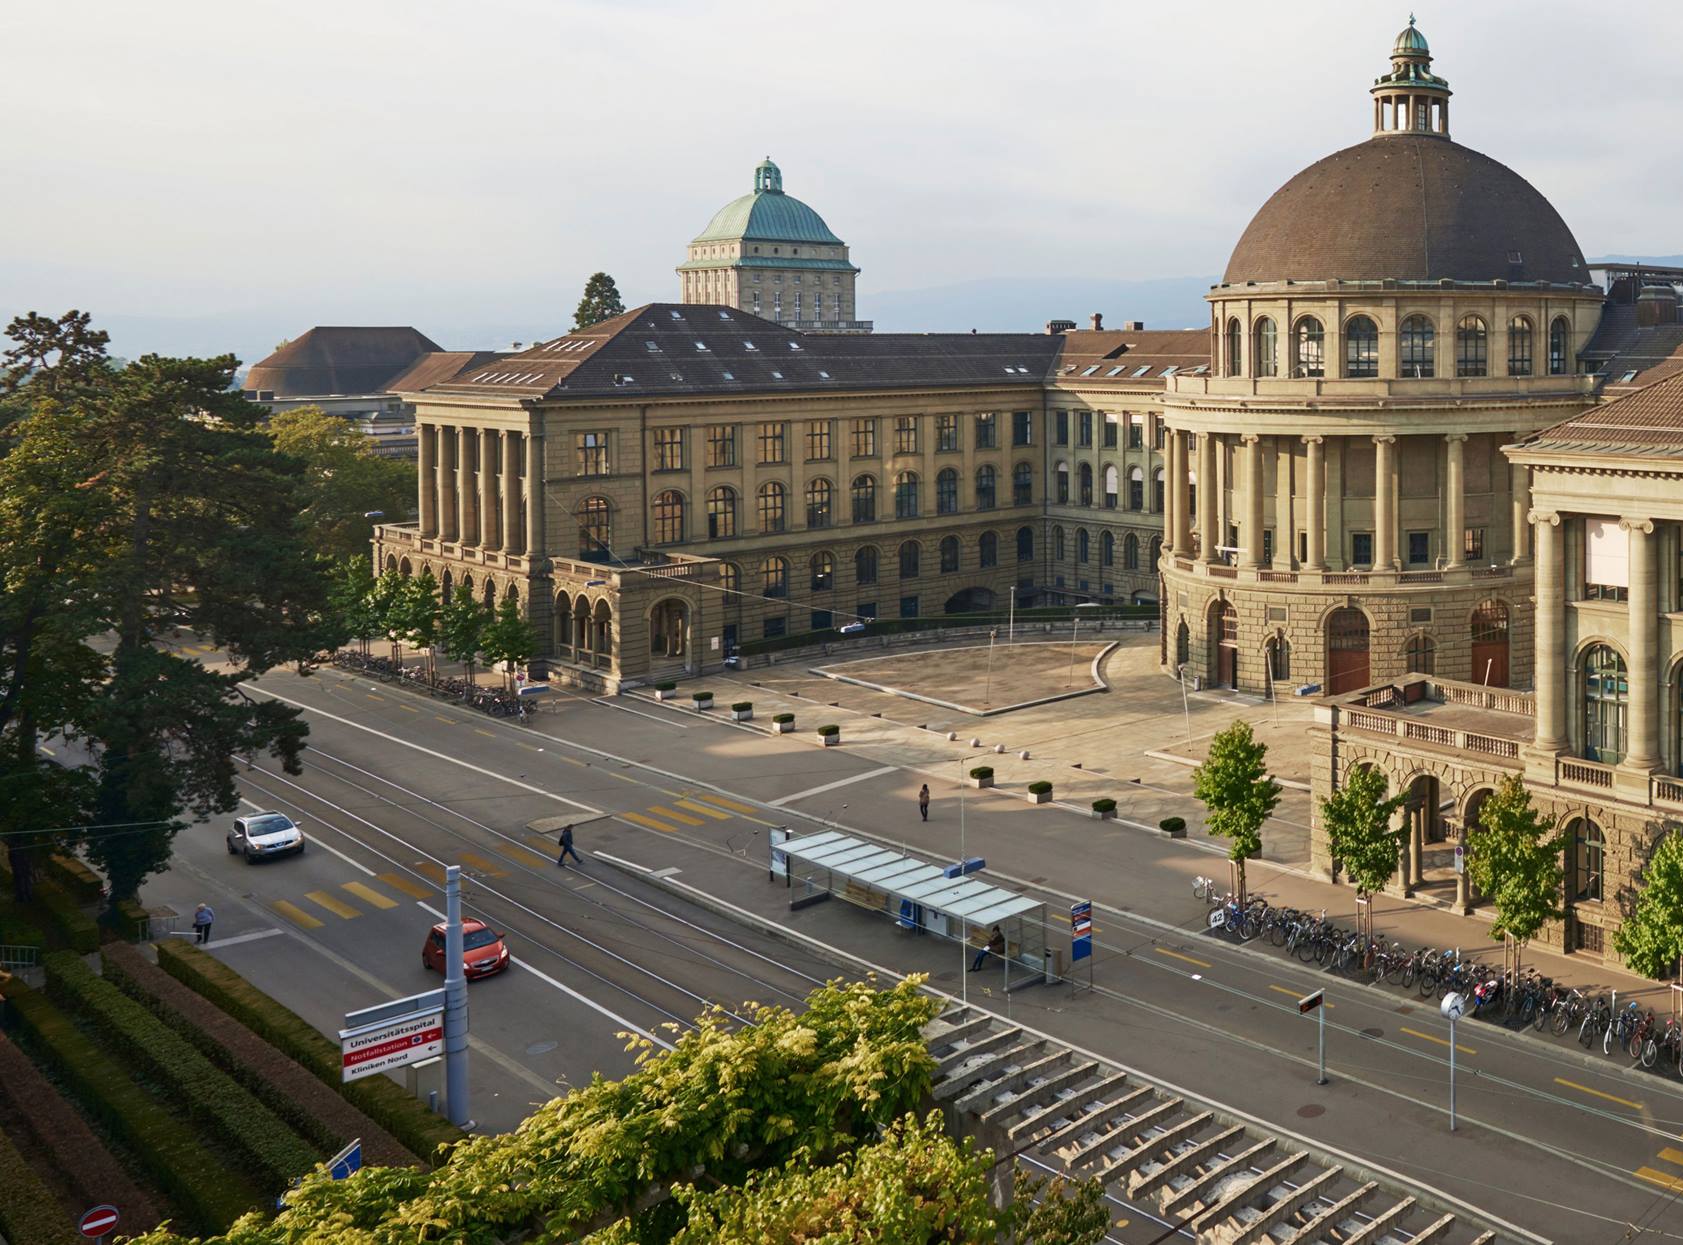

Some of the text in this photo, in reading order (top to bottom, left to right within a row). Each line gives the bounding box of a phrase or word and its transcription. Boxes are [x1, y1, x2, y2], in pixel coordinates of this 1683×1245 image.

[350, 1018, 436, 1048] Universitätsspital
[350, 1040, 408, 1062] Notfallstation
[351, 1052, 409, 1075] Kliniken Nord
